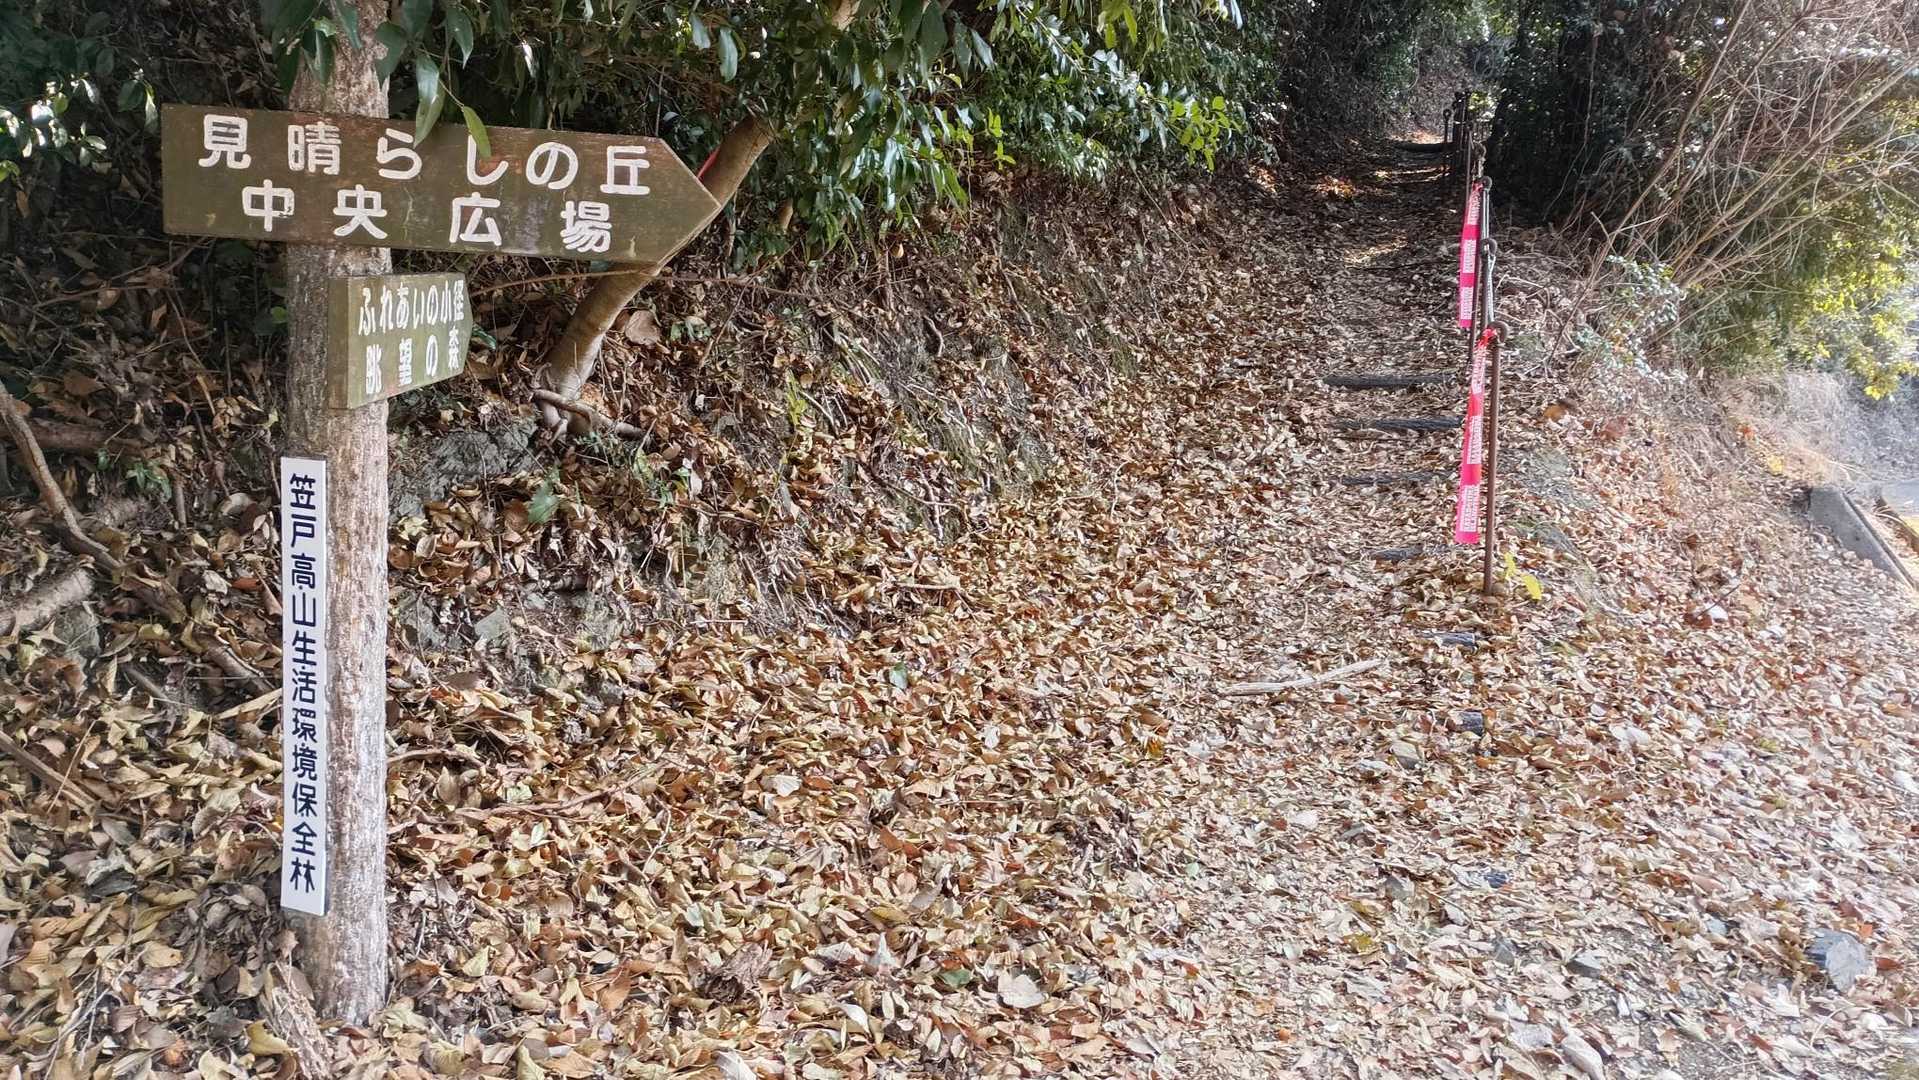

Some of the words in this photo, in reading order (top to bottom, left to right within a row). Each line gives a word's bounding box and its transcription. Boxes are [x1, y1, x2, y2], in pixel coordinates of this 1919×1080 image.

[199, 114, 650, 196] 見晴らしの丘
[242, 179, 612, 254] 中央広場
[358, 279, 465, 336] ふれあいの小径
[365, 326, 459, 394] 眺望の森
[289, 473, 318, 894] 笠戸高山生活環境保全林
